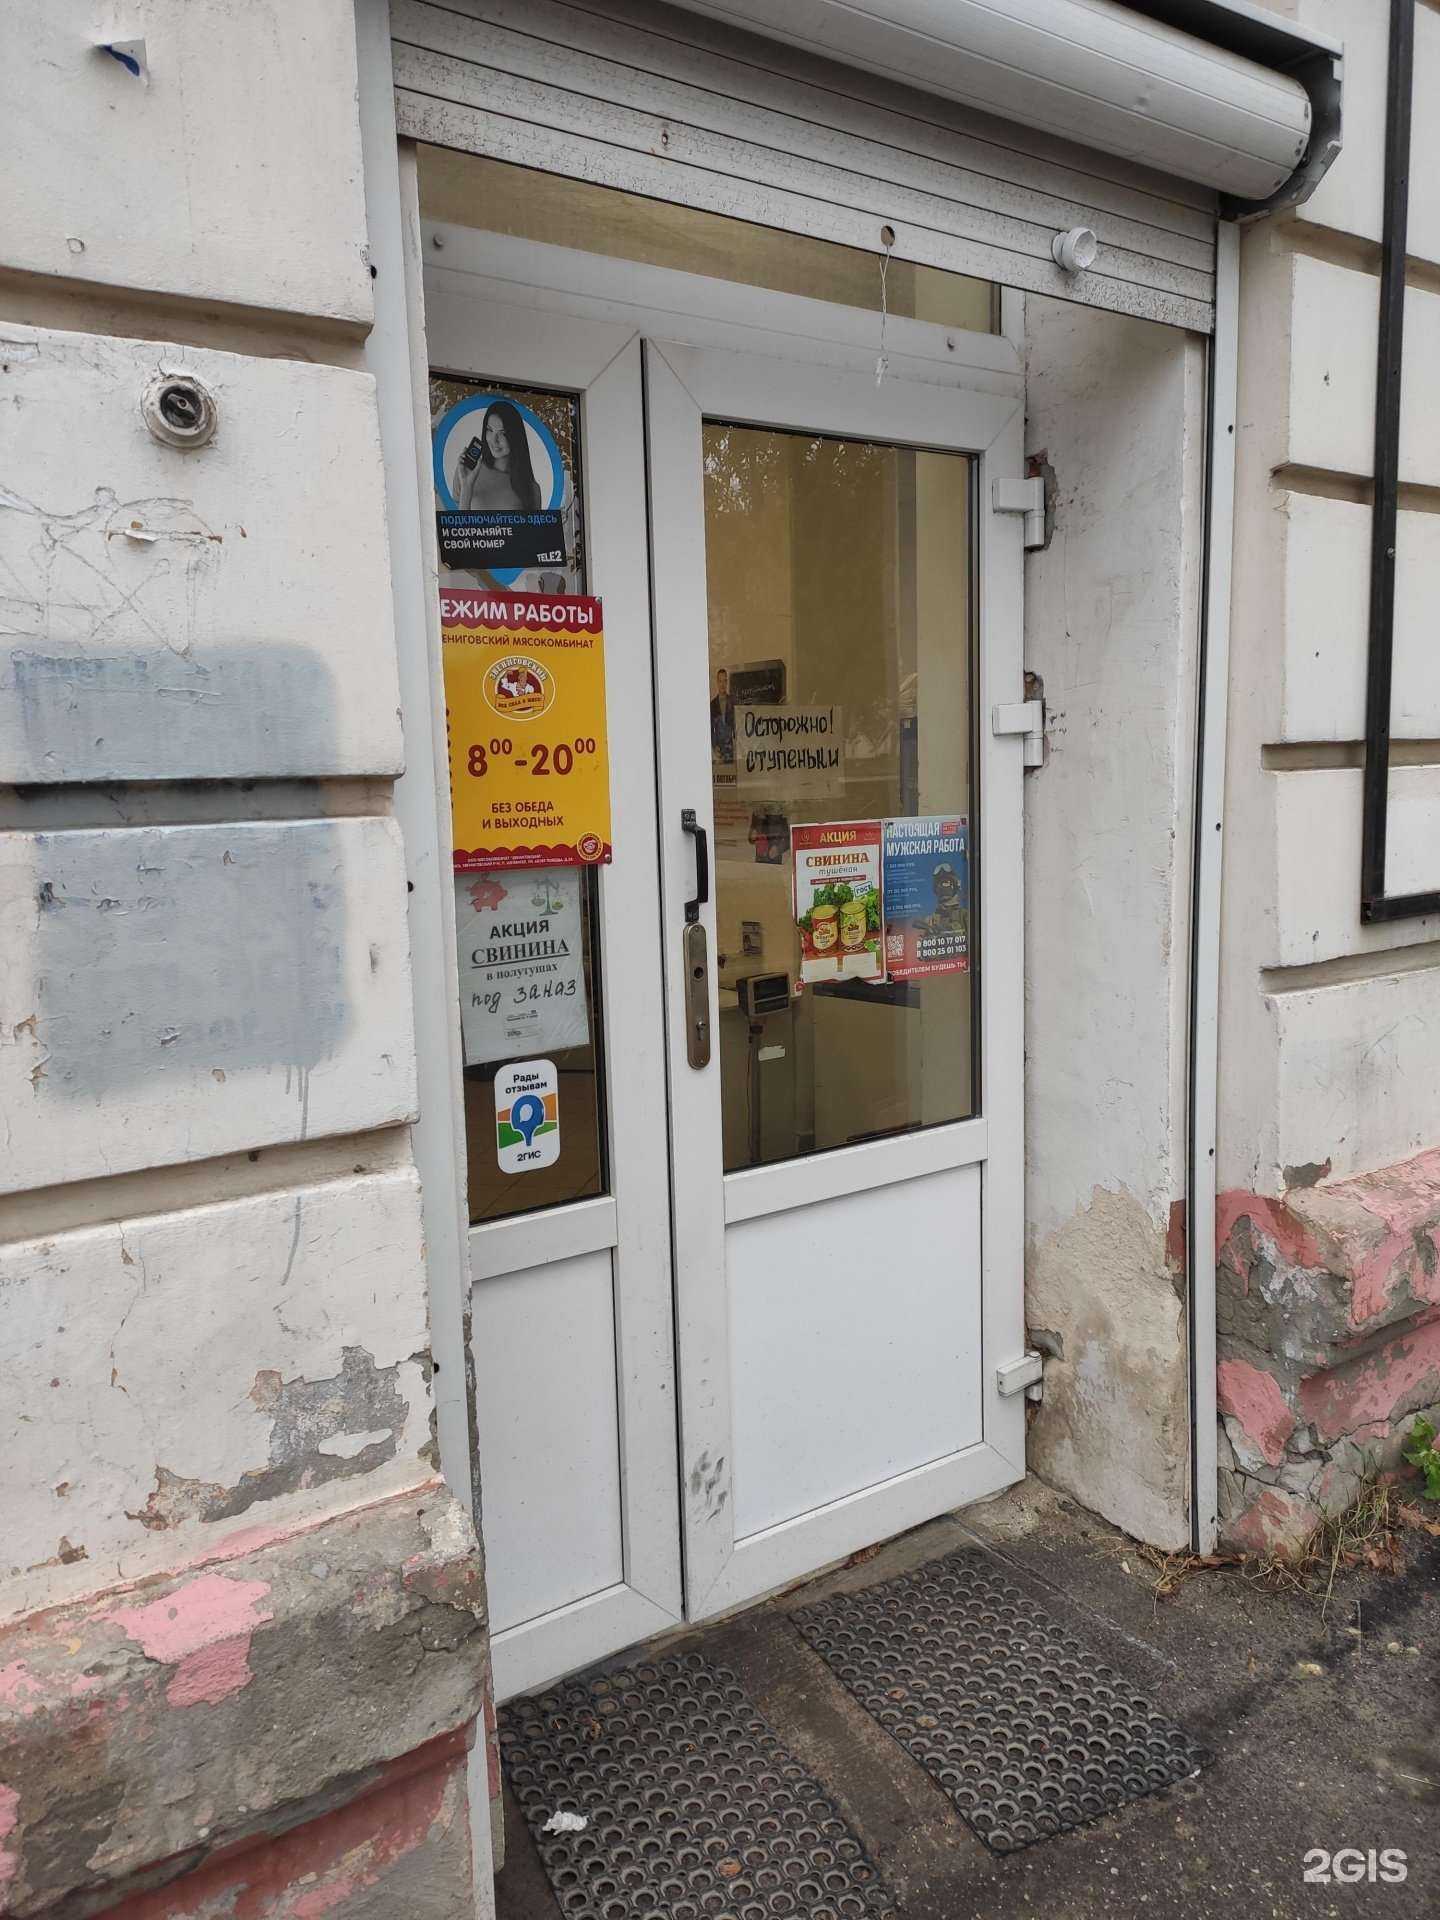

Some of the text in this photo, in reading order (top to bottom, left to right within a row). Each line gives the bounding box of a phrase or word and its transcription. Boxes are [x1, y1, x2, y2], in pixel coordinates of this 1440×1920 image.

[441, 513, 558, 526] ПОДКЛЮЧАЙТЕСЬ ЗДЕСЬ
[442, 526, 513, 537] И СОХРАНЯЙТЕ
[444, 538, 505, 549] СВОЙ НОМЕР
[537, 550, 562, 563] TELE2
[441, 599, 594, 625] ЕЖИМ РАБОТЫ
[442, 634, 594, 649] ЕНИГОВСКИЙ МЯСОКОМБИНАТ
[492, 801, 554, 813] БЕЗ ОБЕДА
[482, 816, 564, 829] И ВЫХОДНЫХ
[886, 822, 940, 838] НАСТОЯЩАЯ
[820, 830, 857, 844] АКЦИЯ
[887, 838, 965, 856] МУЖСКАЯ РАБОТА
[806, 852, 870, 868] СВИНИНА
[490, 919, 549, 940] АКЦИЯ
[471, 938, 570, 965] СВИНИНА
[923, 949, 936, 957] 800
[497, 963, 558, 980] полутушах
[889, 967, 930, 976] ОБЕДИТЕЛЕМ
[472, 992, 502, 1014] под
[513, 1073, 539, 1083] Рады
[505, 1081, 548, 1094] отзывам
[517, 1150, 541, 1161] 2ГИС
